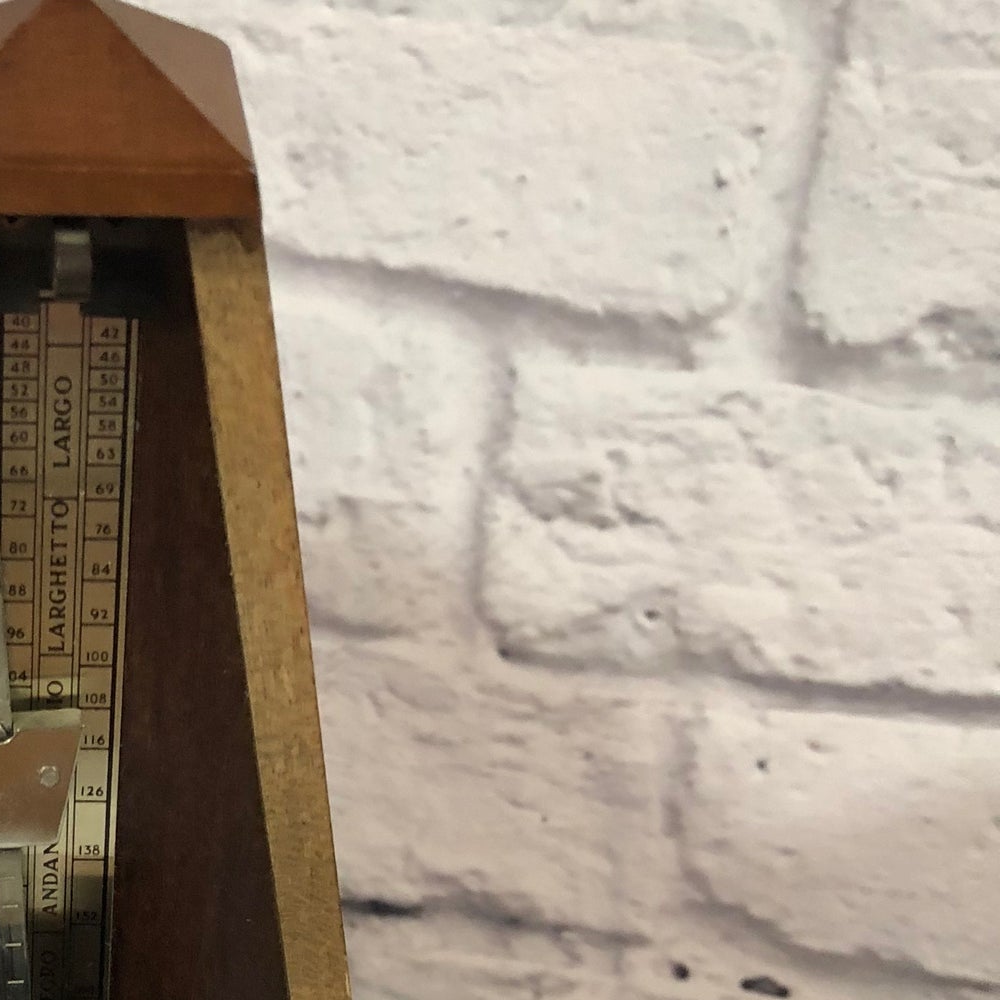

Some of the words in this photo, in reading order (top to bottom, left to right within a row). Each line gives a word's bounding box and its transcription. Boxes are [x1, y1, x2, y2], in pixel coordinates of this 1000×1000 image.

[101, 327, 118, 338] 42
[101, 374, 118, 384] 50
[12, 385, 28, 395] 52
[53, 376, 73, 468] LARGO
[10, 431, 28, 442] 60
[97, 448, 115, 459] 63
[96, 483, 113, 494] 69
[11, 501, 26, 510] 72
[97, 524, 111, 534] 76
[10, 542, 27, 553] 80
[92, 564, 110, 574] 84
[48, 500, 69, 652] LARGHETTO
[9, 584, 26, 595] 88
[91, 609, 107, 619] 92
[7, 627, 24, 639] 96
[86, 651, 108, 661] 100
[9, 671, 27, 681] 04
[86, 693, 106, 703] 108
[84, 735, 104, 745] 116
[81, 786, 103, 796] 126
[79, 845, 100, 855] 138
[42, 842, 59, 916] ANDAN
